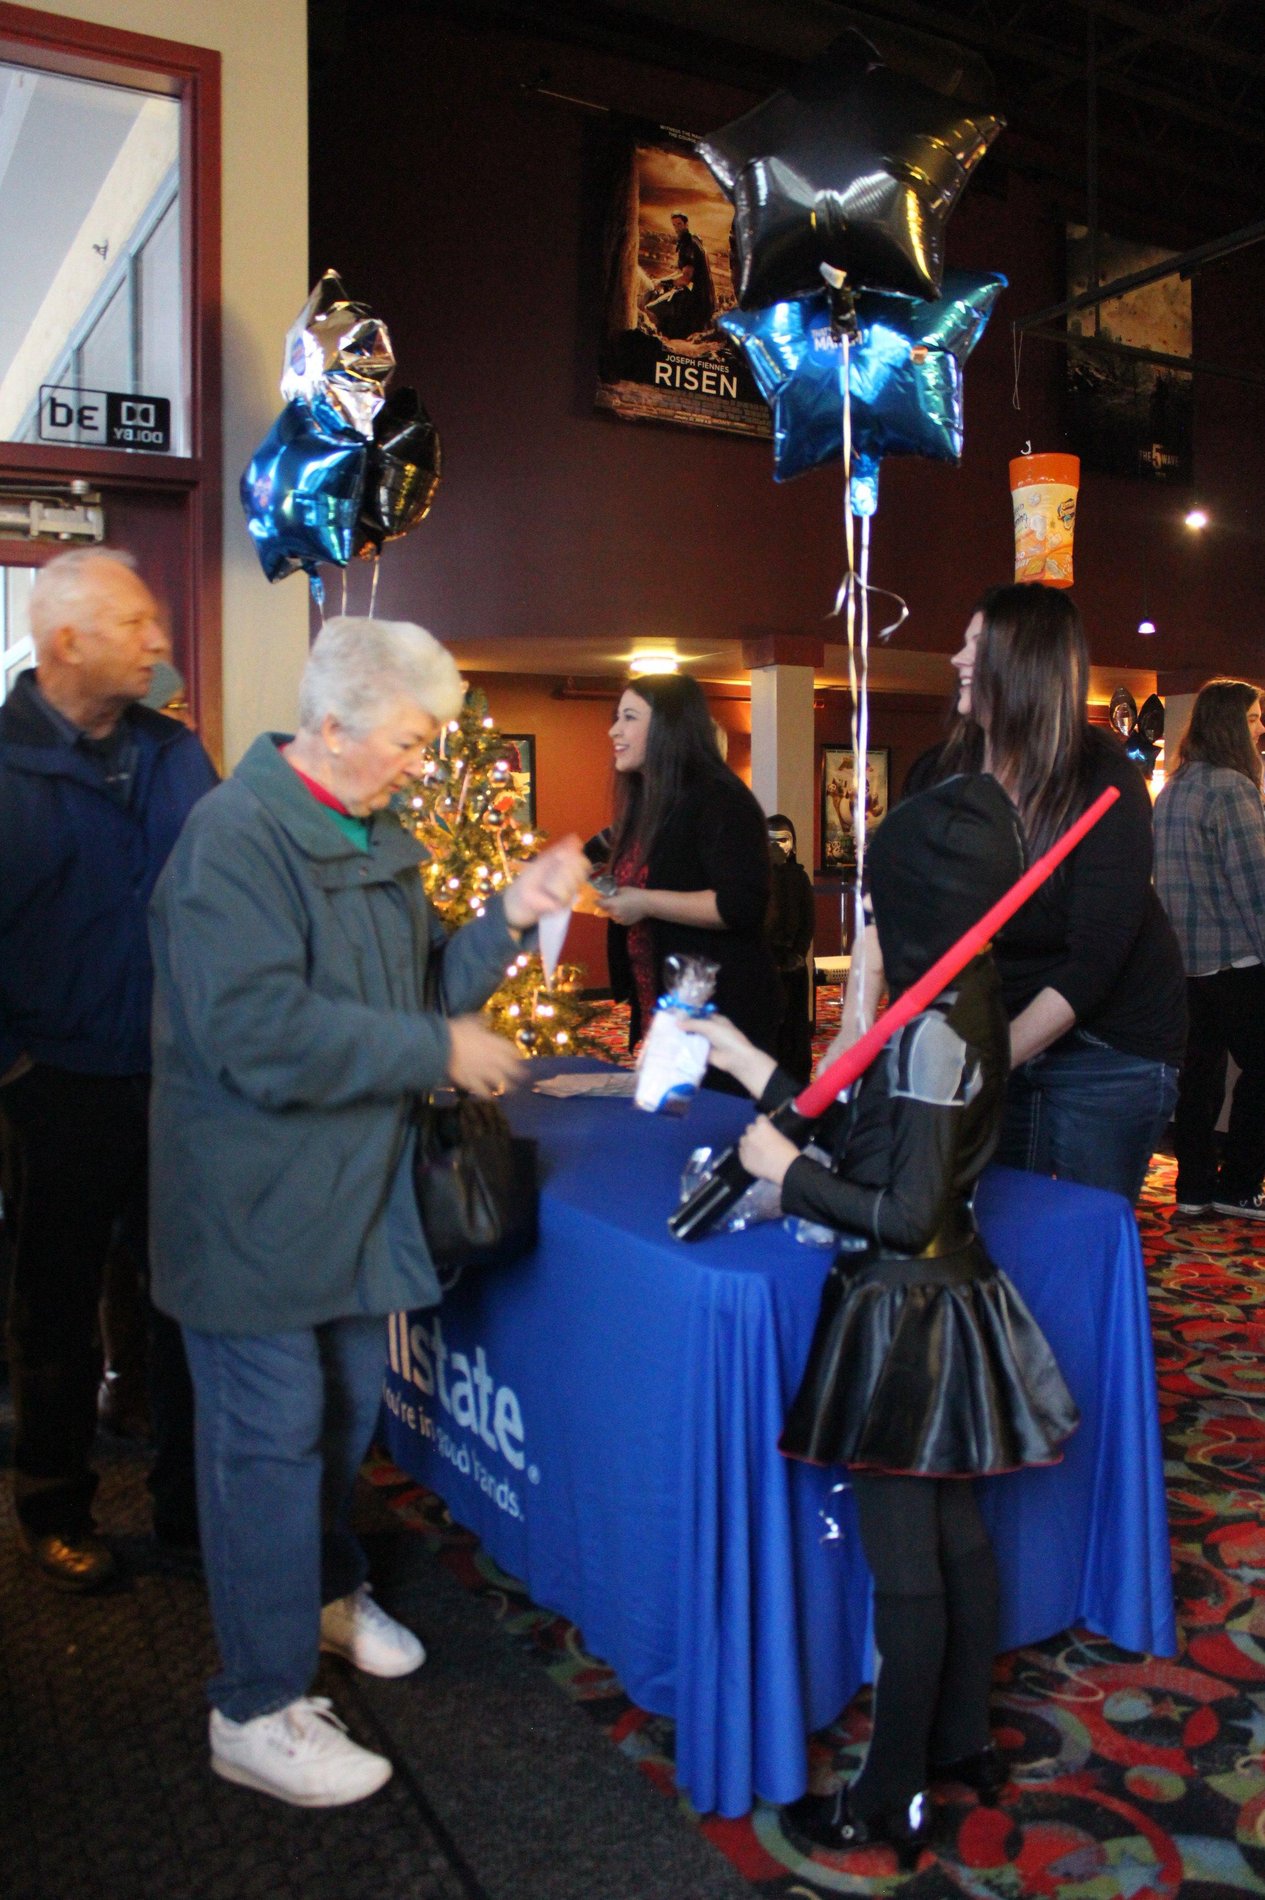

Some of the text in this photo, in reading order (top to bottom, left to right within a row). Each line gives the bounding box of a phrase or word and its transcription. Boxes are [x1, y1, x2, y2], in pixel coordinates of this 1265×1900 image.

[655, 361, 738, 399] RISEN
[665, 354, 730, 373] JOSEPH FIENNES
[386, 1310, 526, 1472] llstate
